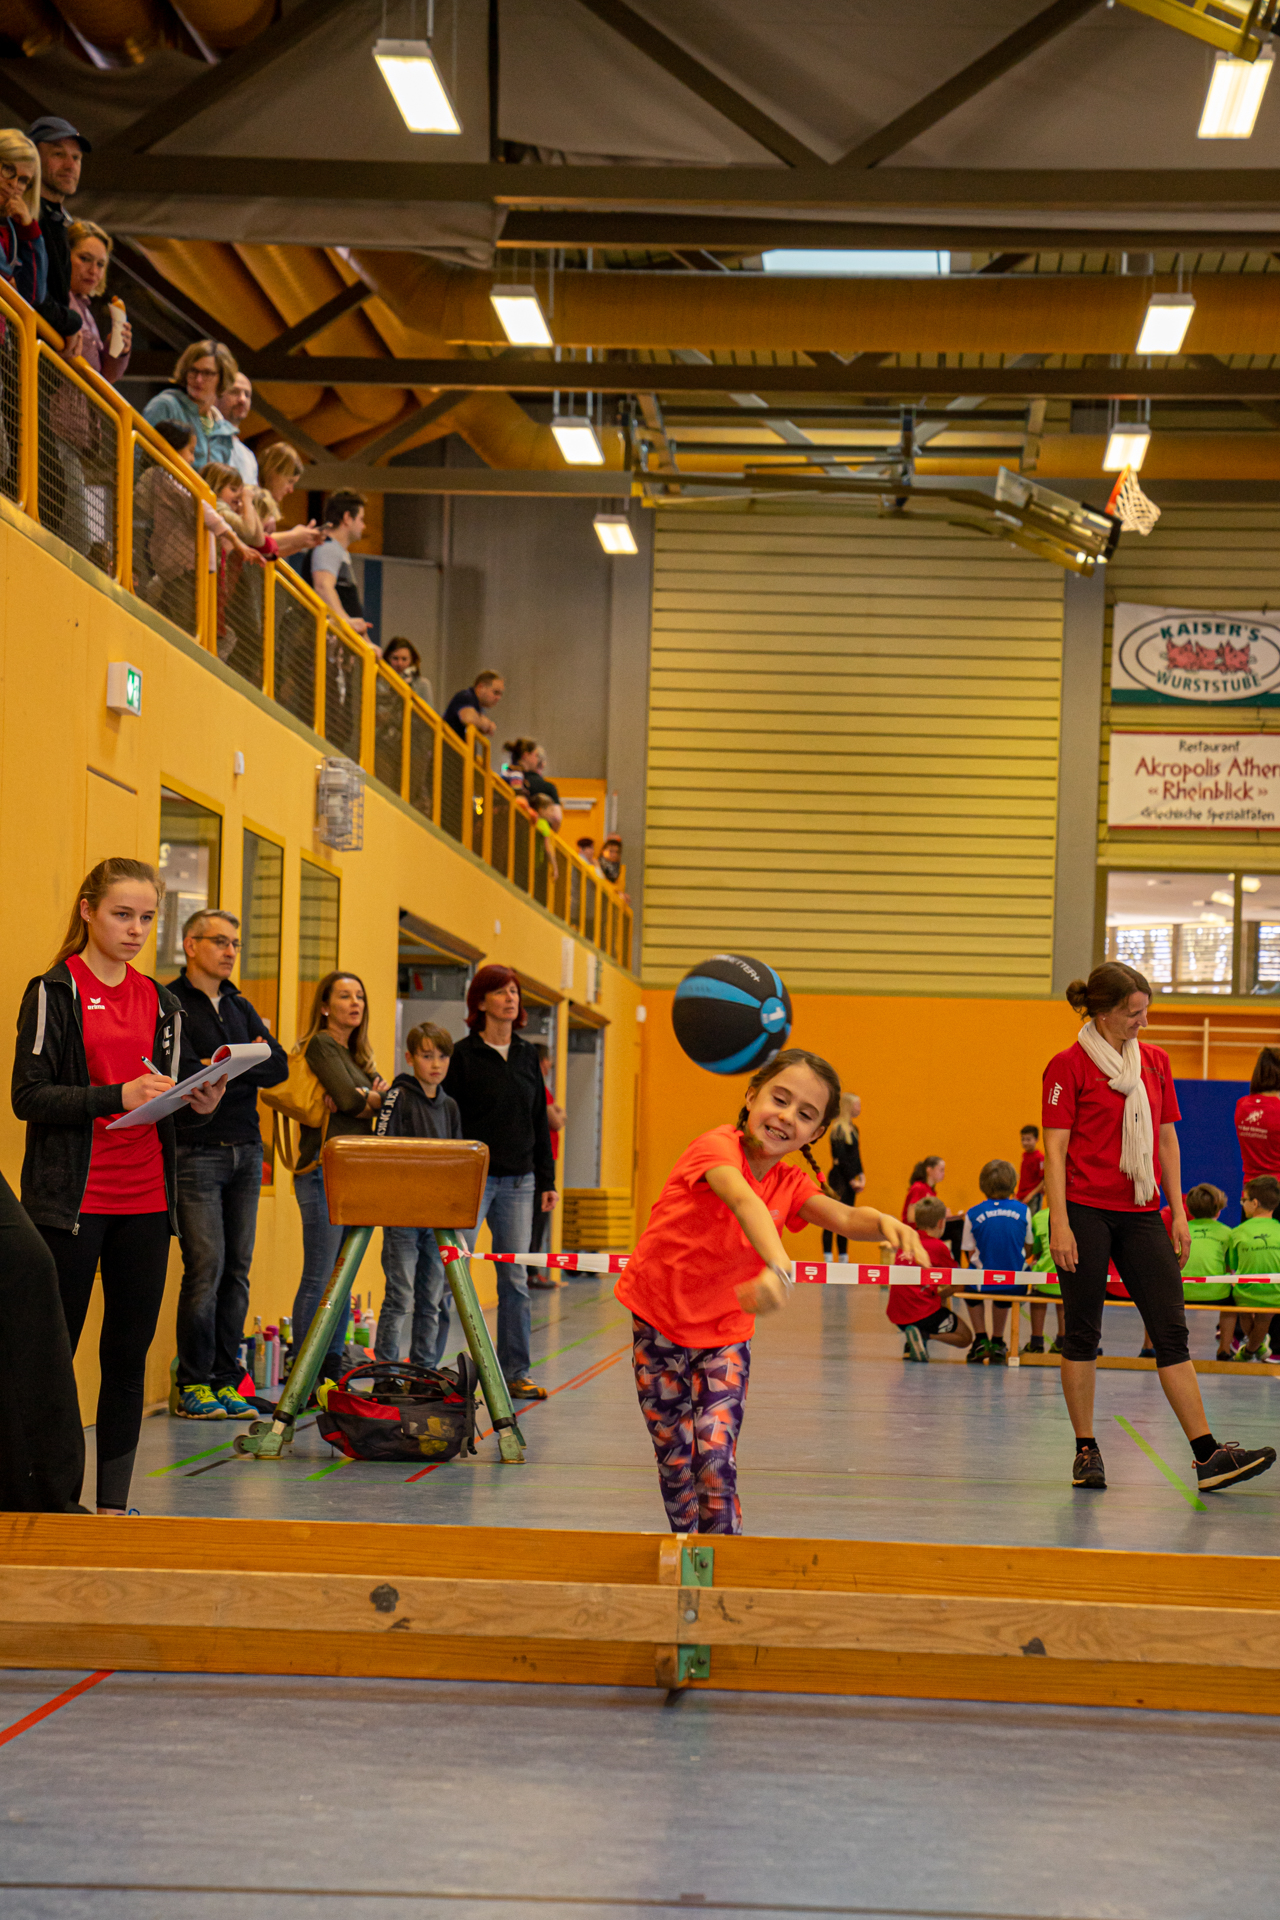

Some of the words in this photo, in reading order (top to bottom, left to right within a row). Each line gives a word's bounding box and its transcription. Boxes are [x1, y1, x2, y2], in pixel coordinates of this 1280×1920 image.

[1160, 622, 1261, 642] KAISER'S
[1156, 669, 1262, 693] WURSTSTUBE
[1178, 739, 1241, 753] Restaurant
[1134, 756, 1221, 783] Akropolis
[1226, 756, 1280, 779] Athen
[1162, 780, 1255, 802] Rheinblick
